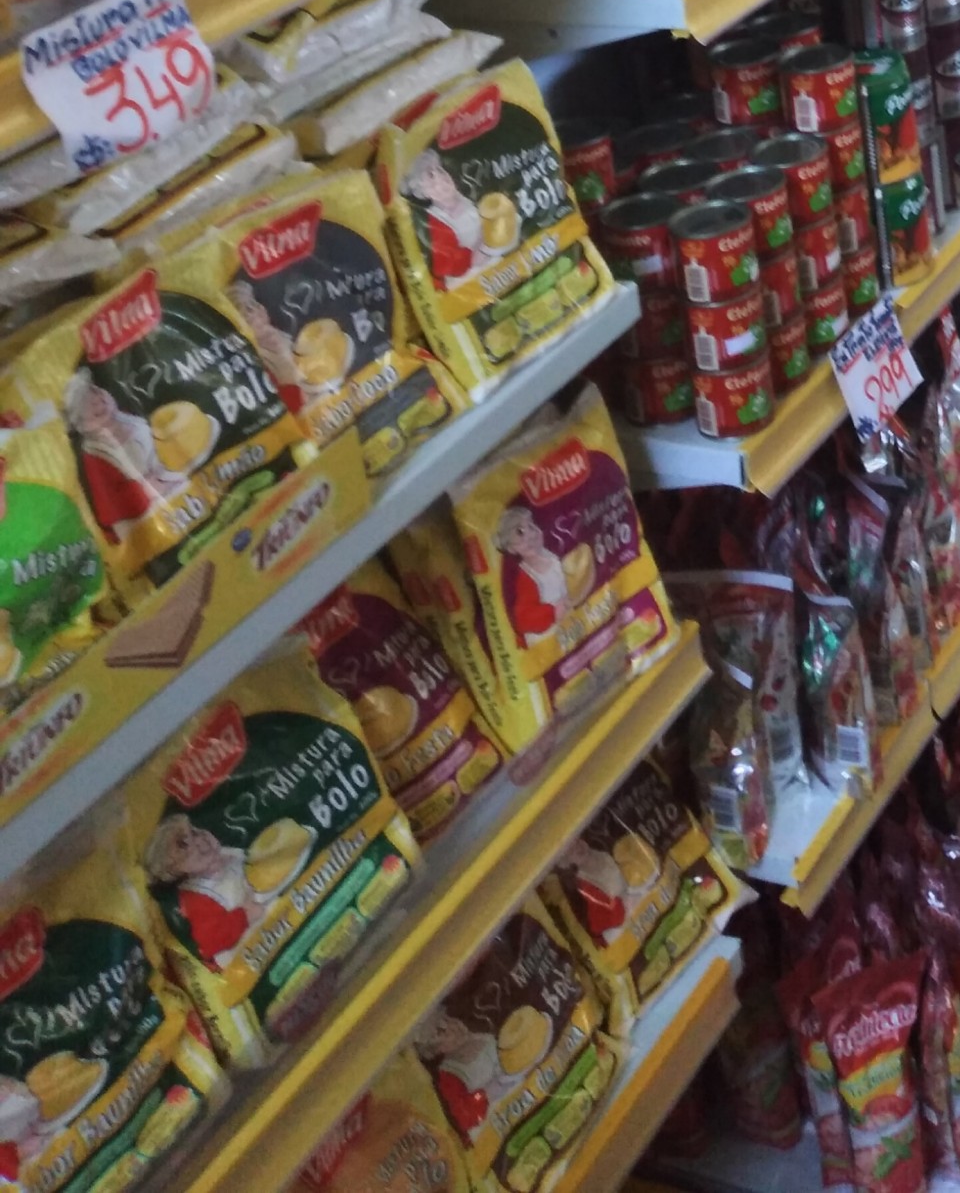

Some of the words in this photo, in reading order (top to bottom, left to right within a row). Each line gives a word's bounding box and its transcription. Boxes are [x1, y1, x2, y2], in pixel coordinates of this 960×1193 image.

[241, 220, 311, 271] Vilma
[82, 292, 154, 353] Vilma
[525, 452, 587, 500] Vilma
[171, 720, 240, 798] Vilma
[268, 726, 343, 800] Mistura
[313, 740, 355, 788] para
[307, 762, 370, 829] Bolo
